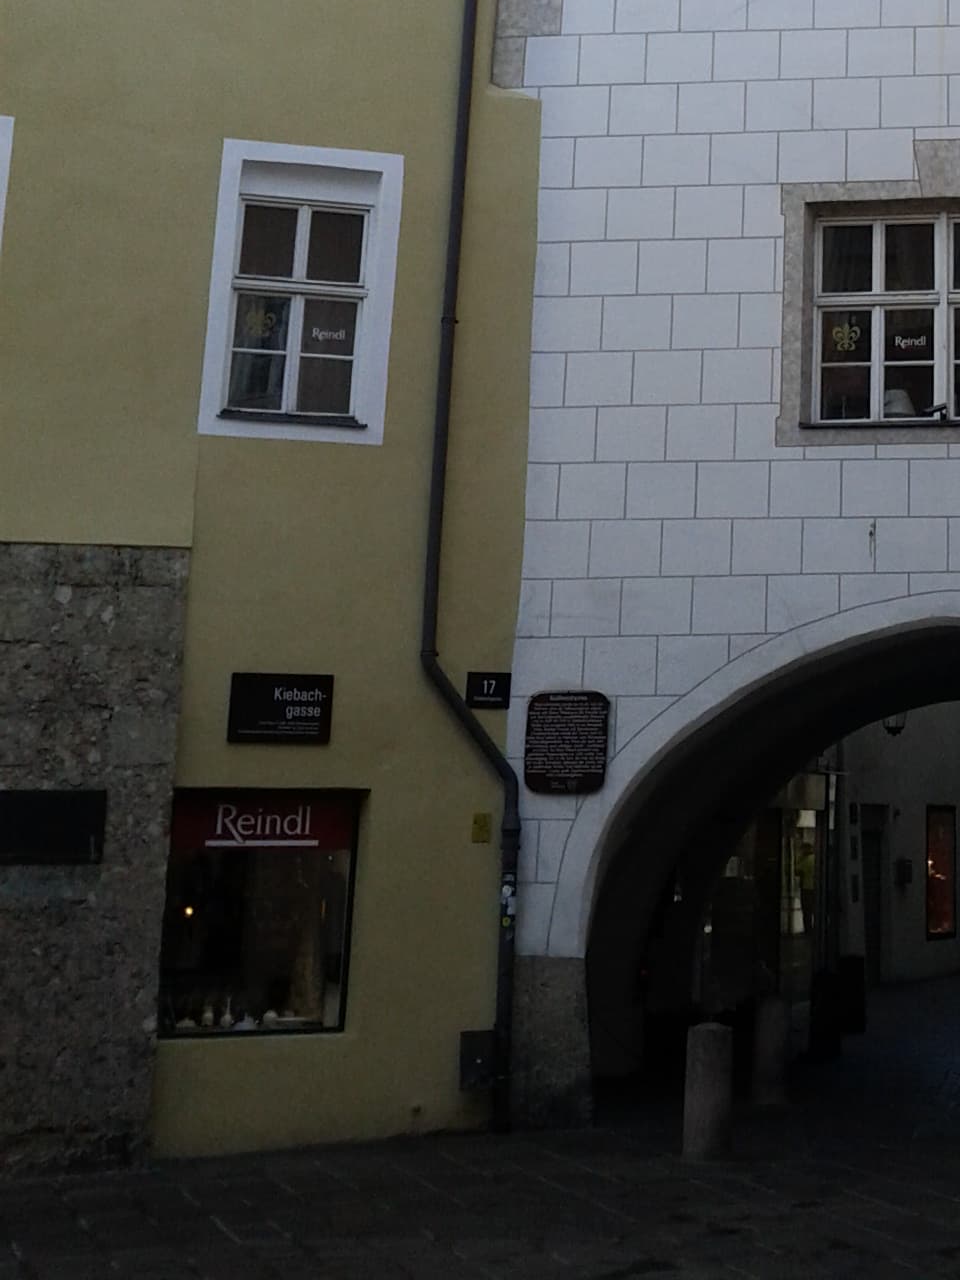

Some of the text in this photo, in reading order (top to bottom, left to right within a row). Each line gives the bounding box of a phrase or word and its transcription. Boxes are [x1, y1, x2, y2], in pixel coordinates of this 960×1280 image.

[312, 327, 346, 342] Reindl
[894, 335, 927, 350] Reindl
[273, 687, 327, 701] Kiebach-
[483, 679, 496, 695] 17
[285, 706, 321, 719] gasse
[215, 803, 312, 842] Reindl
